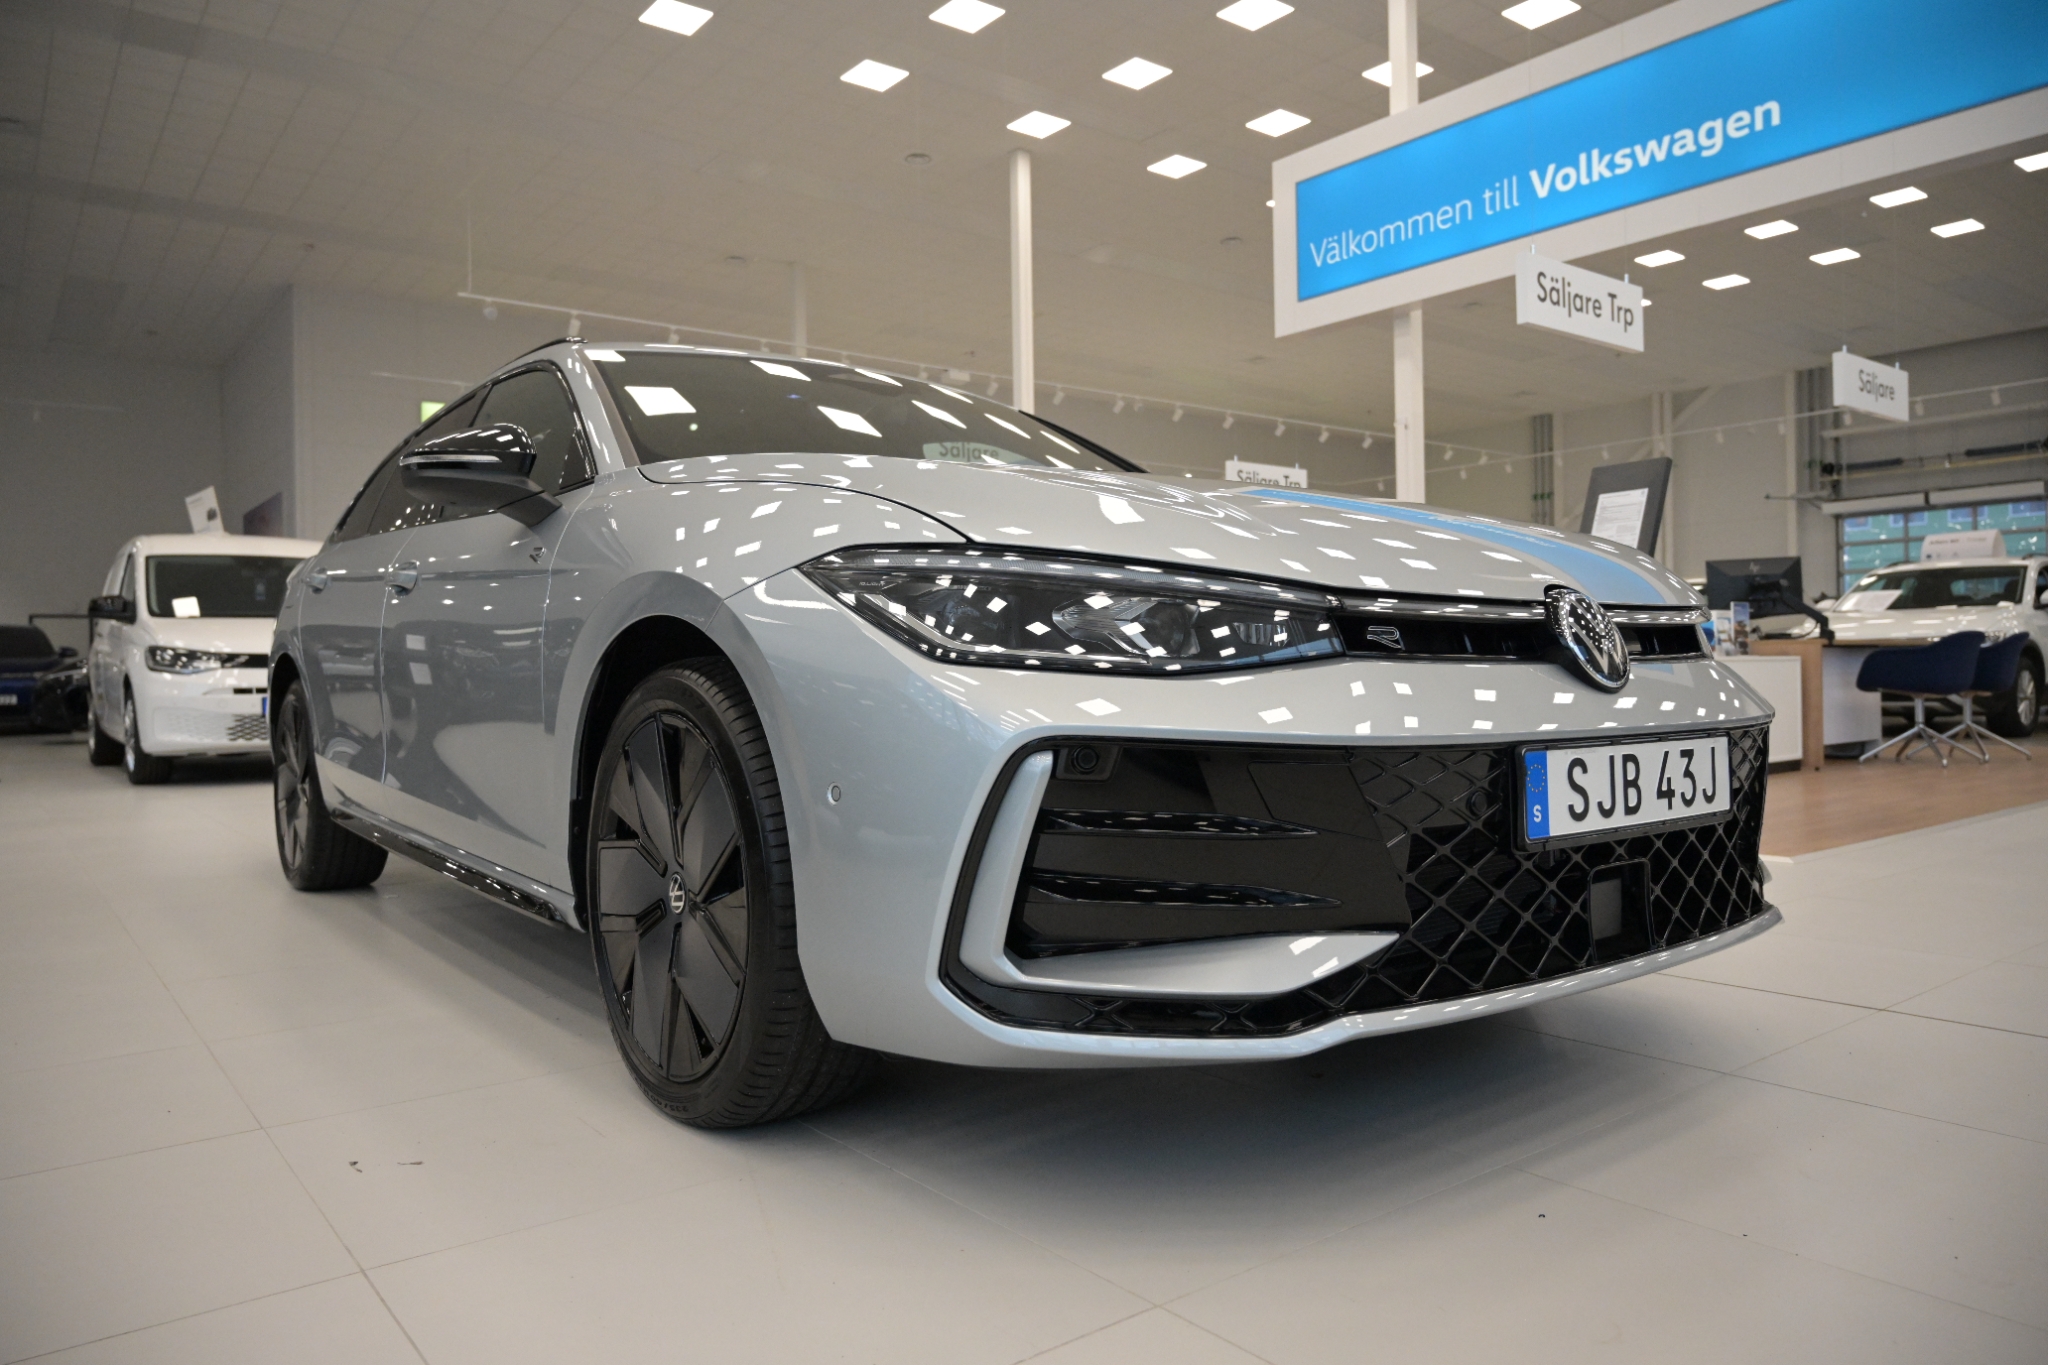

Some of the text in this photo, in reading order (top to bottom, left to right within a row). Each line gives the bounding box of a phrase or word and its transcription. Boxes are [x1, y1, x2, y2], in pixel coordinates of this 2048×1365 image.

[1310, 100, 1781, 268] Välkommen till Volkswagen
[1537, 271, 1634, 333] Säljare Trp
[1858, 368, 1895, 402] Säljare
[1533, 804, 1542, 823] S
[1567, 746, 1717, 822] SJB 43J
